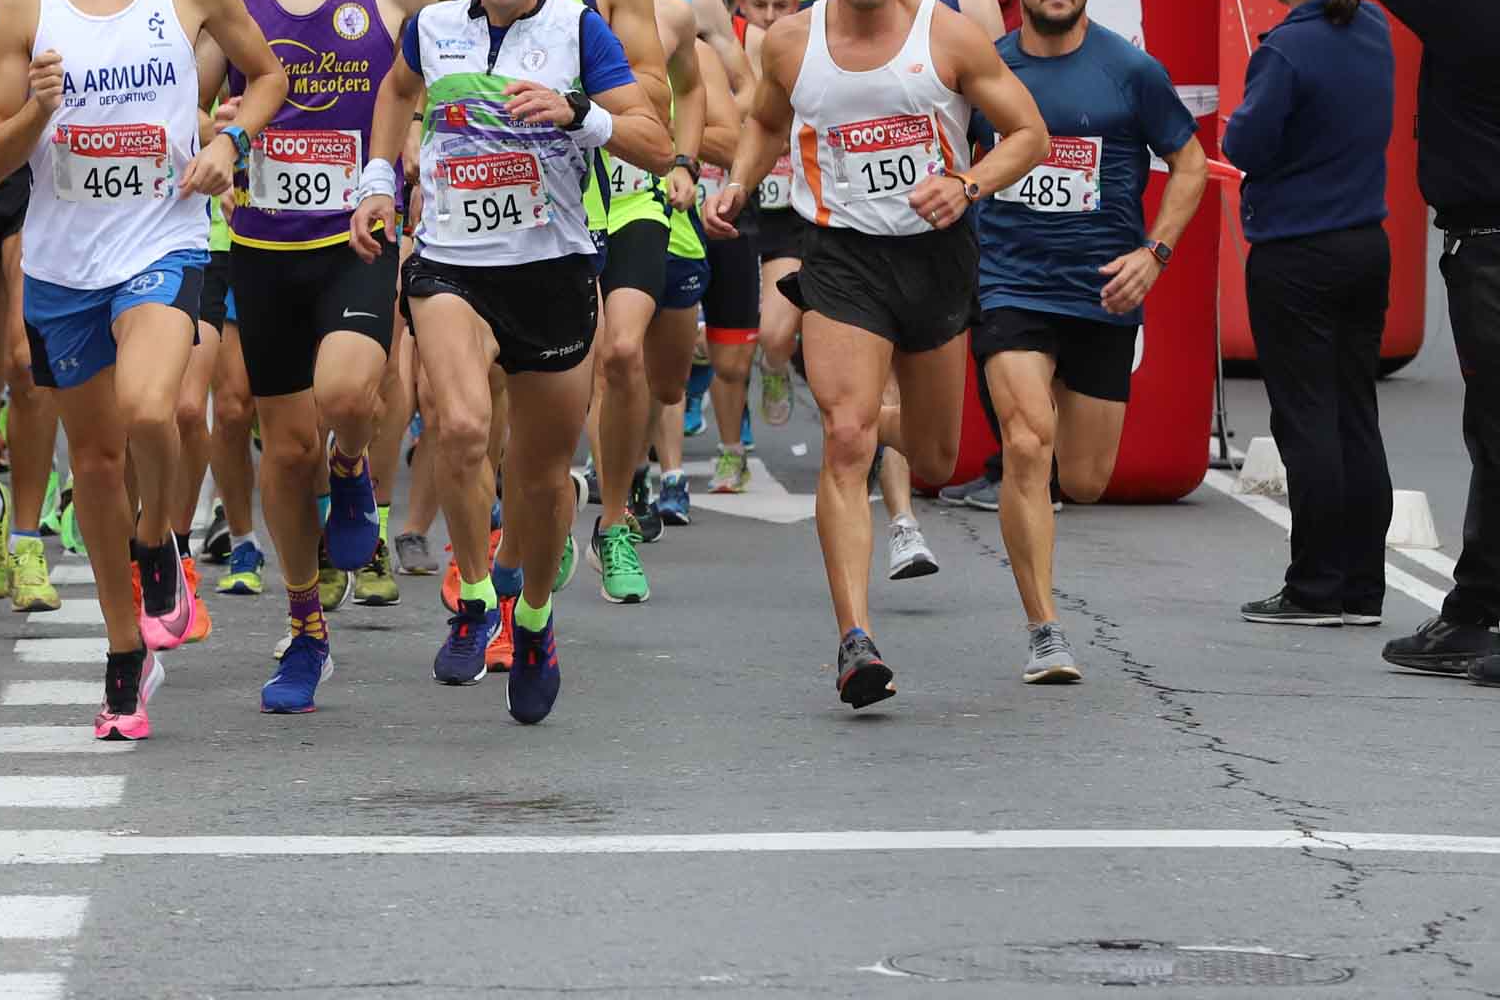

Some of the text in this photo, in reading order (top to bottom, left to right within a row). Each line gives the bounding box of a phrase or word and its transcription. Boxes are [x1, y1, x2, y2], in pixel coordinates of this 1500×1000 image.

[83, 57, 177, 93] ARMUÑA
[317, 51, 369, 73] Ruano
[294, 74, 371, 94] Macotera
[83, 165, 143, 198] 464
[276, 172, 331, 206] 389
[861, 154, 917, 193] 150
[1019, 175, 1072, 207] 485
[463, 194, 522, 233] 594
